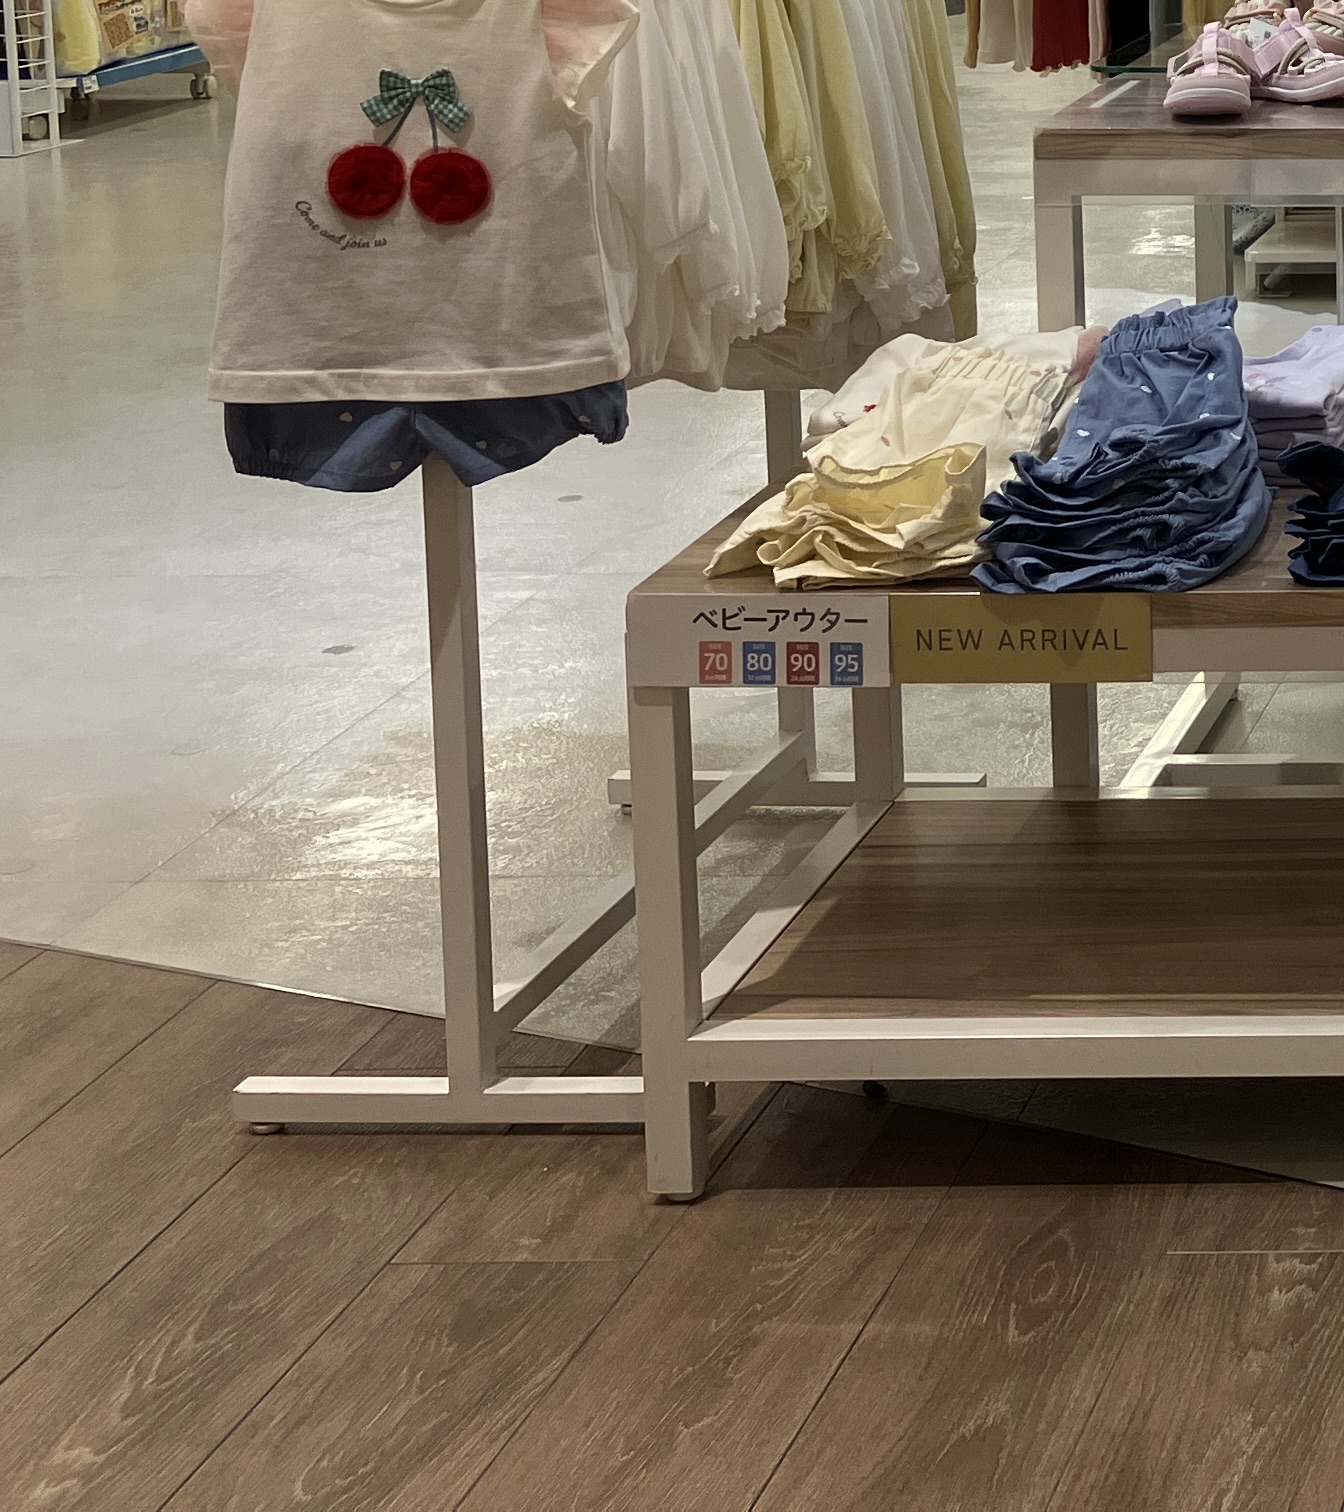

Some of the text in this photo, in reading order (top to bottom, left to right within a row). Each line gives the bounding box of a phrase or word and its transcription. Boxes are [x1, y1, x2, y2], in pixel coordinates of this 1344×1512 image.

[295, 200, 387, 251] Come and join us
[691, 606, 870, 634] ベビーアウター
[915, 628, 1129, 652] NEW ARRIVAL
[703, 652, 859, 672] 70 80 90 95
